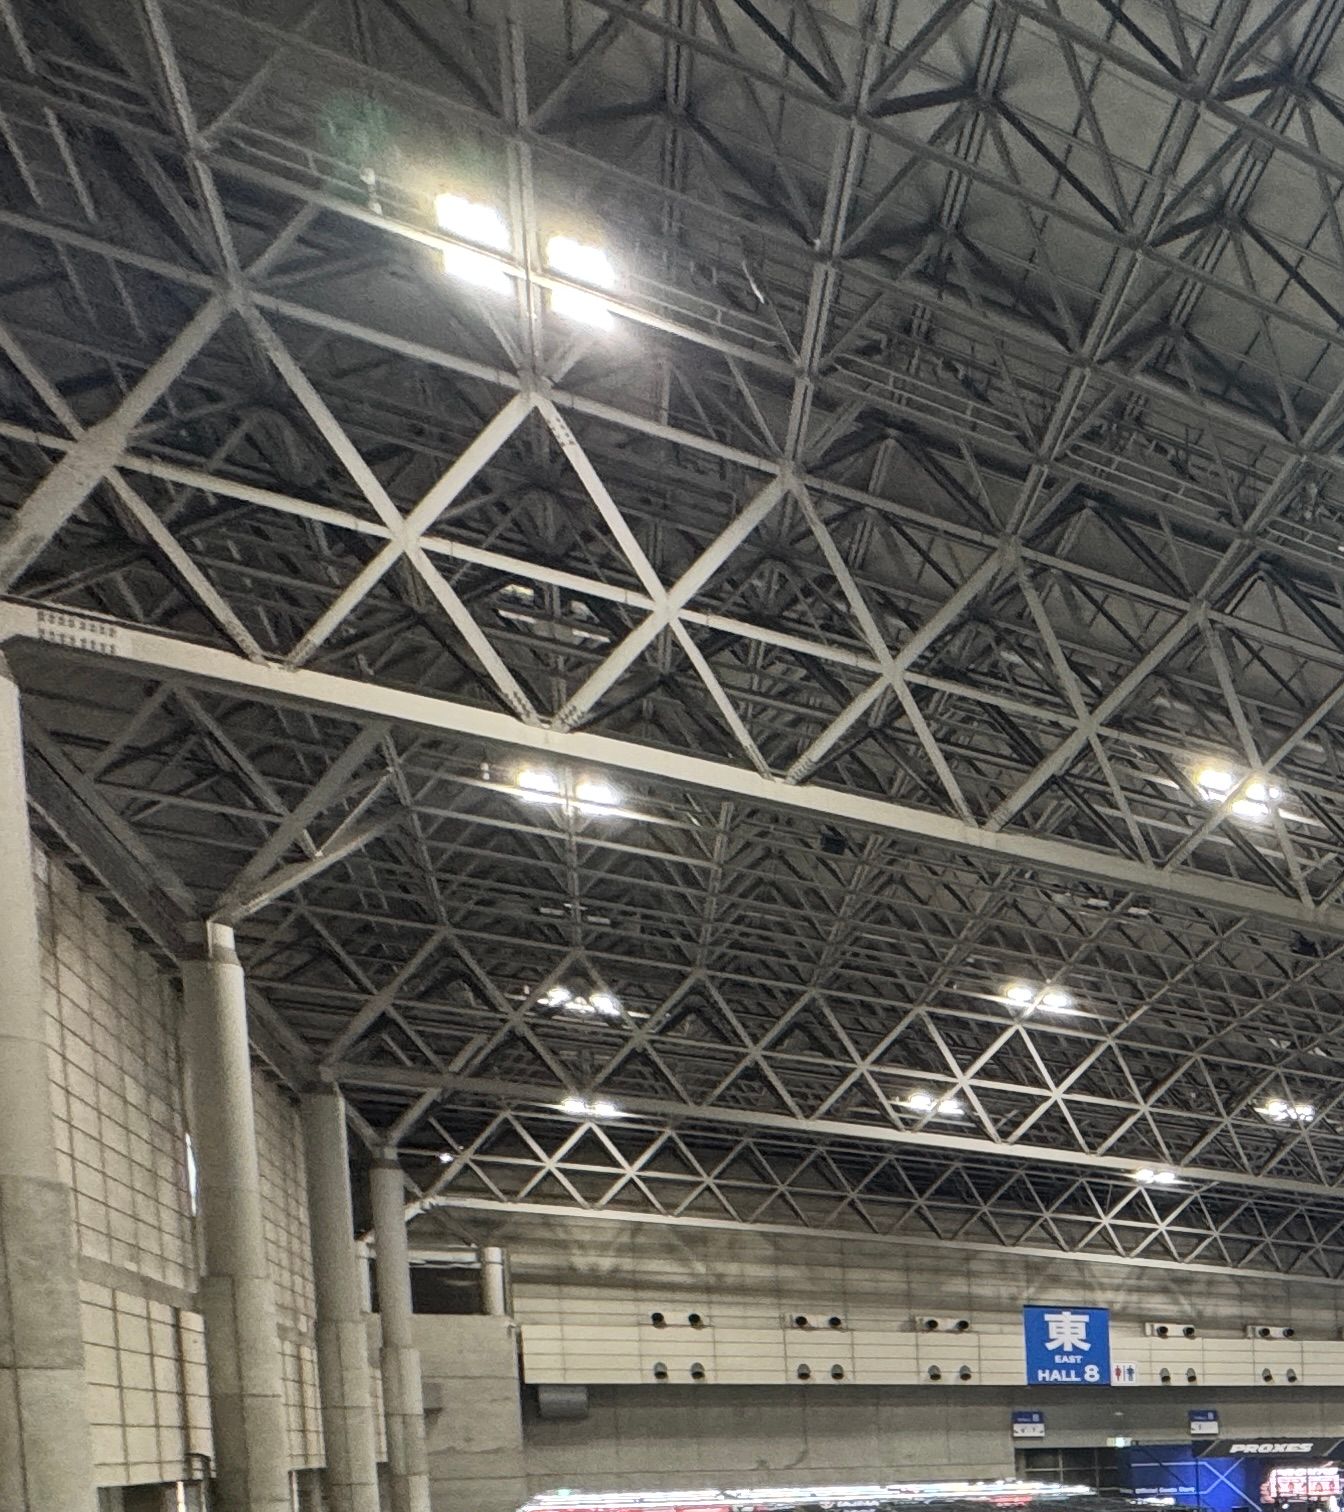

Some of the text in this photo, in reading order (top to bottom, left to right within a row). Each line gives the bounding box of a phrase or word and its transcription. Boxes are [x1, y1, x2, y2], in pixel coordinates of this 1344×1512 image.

[1044, 1311, 1091, 1351] 東
[1054, 1355, 1083, 1363] EAST
[1038, 1364, 1100, 1382] HALL 8
[1229, 1443, 1314, 1453] PROXES
